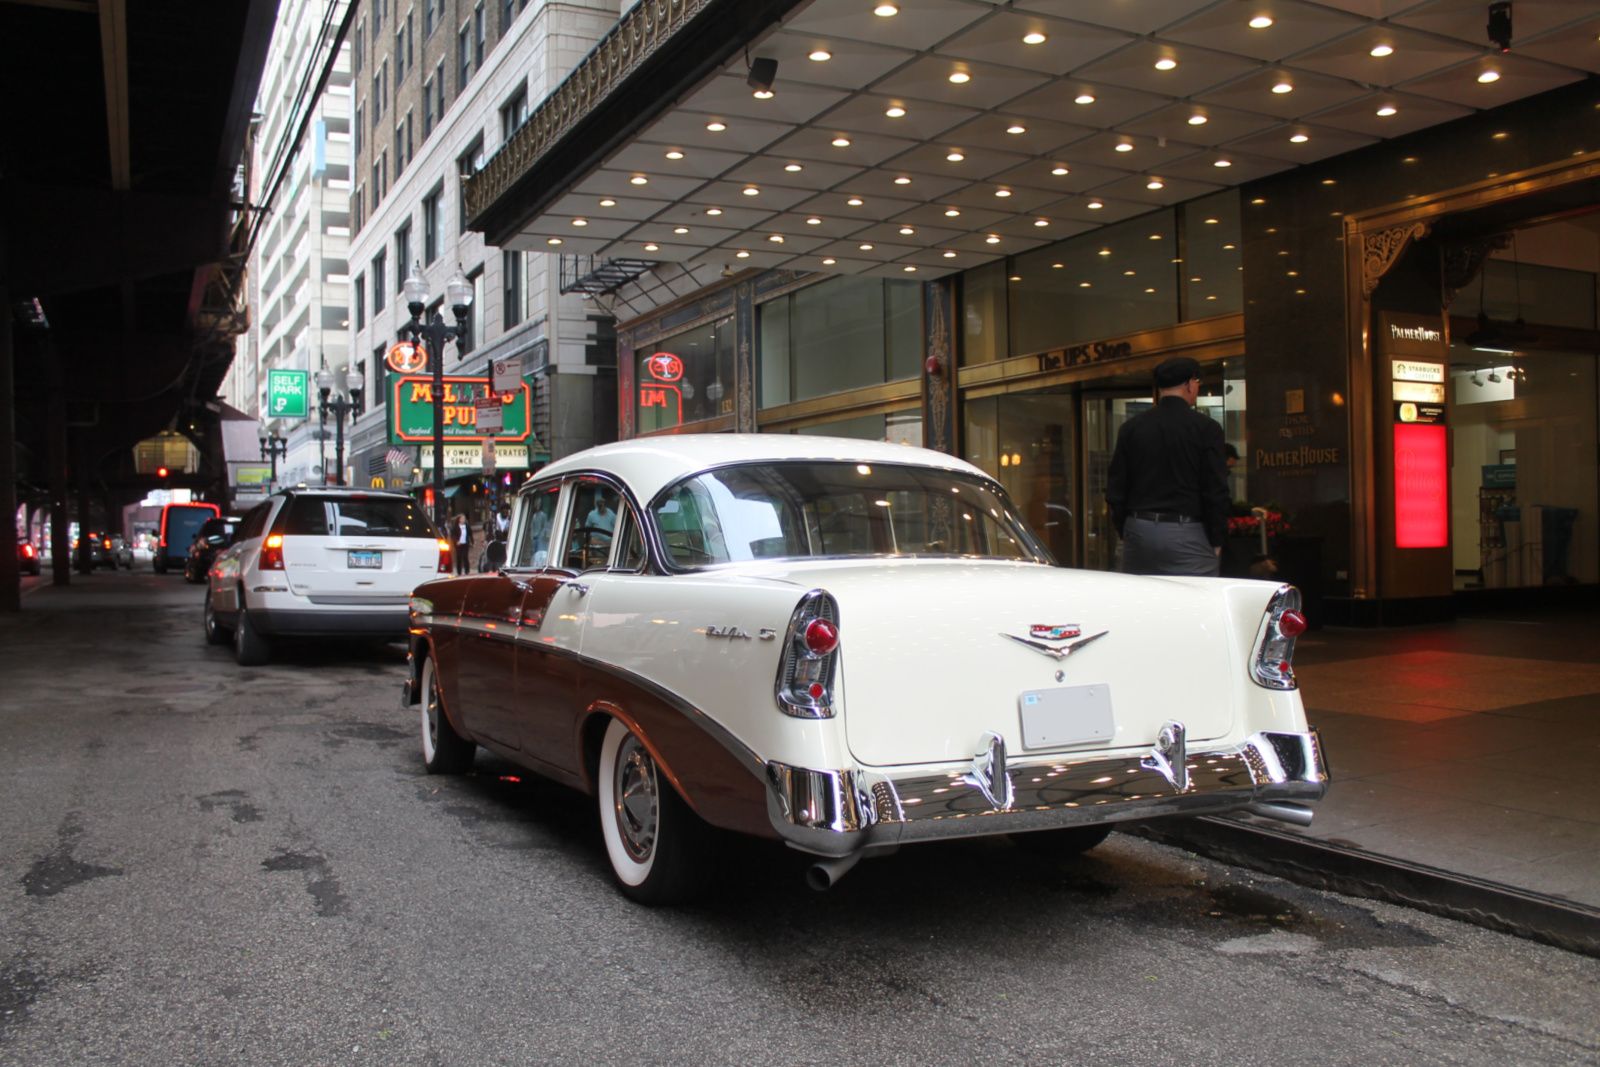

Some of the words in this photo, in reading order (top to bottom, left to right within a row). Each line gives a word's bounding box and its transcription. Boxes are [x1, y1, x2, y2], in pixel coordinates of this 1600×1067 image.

[1038, 352, 1061, 371] The
[1063, 346, 1090, 366] UPS
[1093, 342, 1132, 362] Store
[1408, 365, 1440, 374] STARBUCKS
[274, 375, 301, 385] SELF
[274, 385, 302, 395] PARK
[411, 383, 514, 403] MLLES
